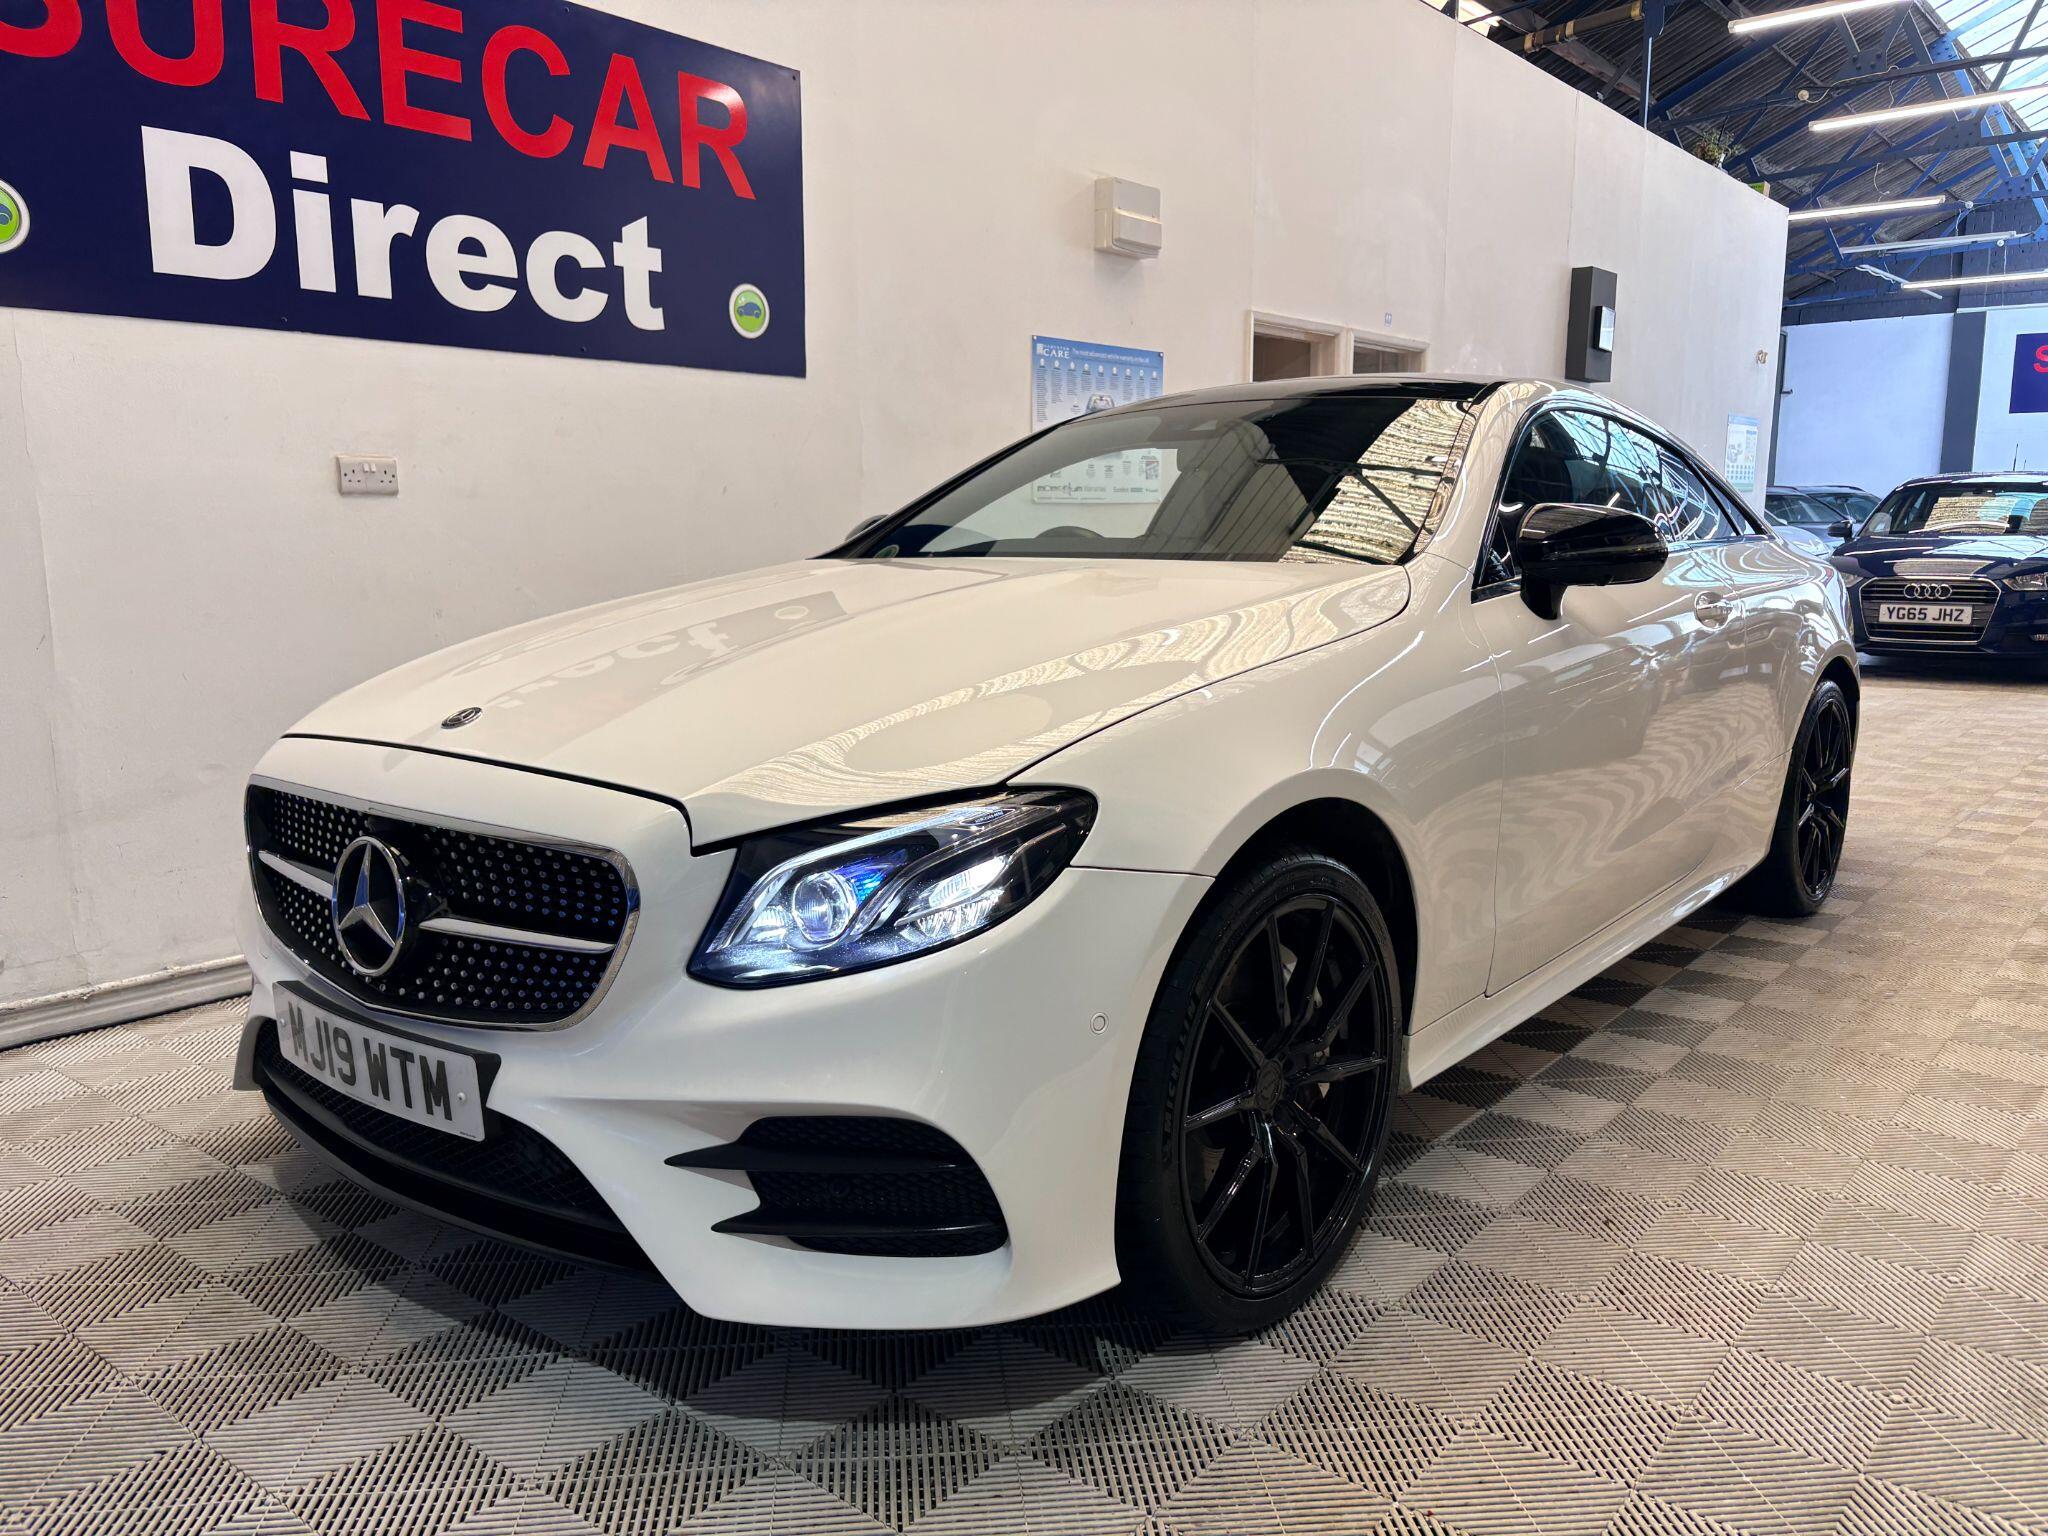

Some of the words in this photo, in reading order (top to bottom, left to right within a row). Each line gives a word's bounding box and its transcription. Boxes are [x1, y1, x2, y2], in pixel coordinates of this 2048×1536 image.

[141, 125, 665, 331] Direct
[1043, 347, 1070, 359] CARE
[1887, 606, 1928, 621] YG65
[1932, 608, 1964, 622] JHZ
[287, 1001, 357, 1087] MJ19
[363, 1036, 453, 1122] WTM
